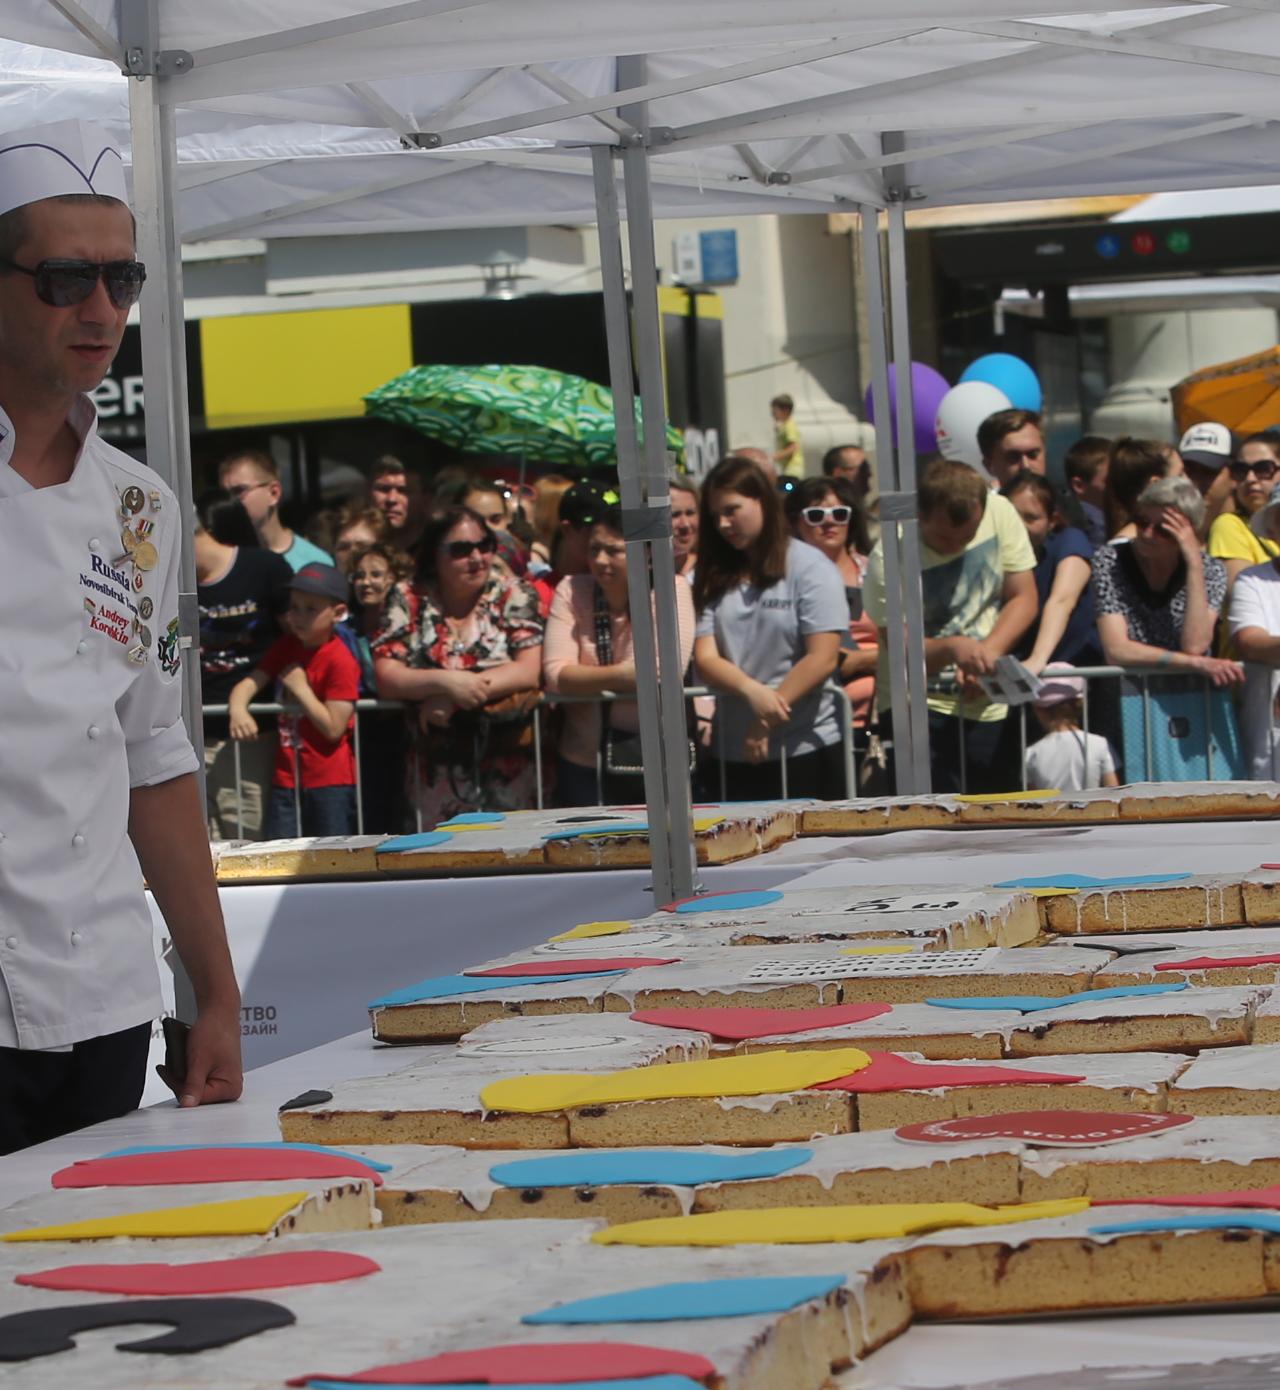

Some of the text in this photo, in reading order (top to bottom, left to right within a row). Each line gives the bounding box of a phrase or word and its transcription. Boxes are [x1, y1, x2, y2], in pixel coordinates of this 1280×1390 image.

[91, 553, 130, 591] Russia
[79, 573, 125, 605] Novosibirsk
[98, 604, 129, 630] Andrey
